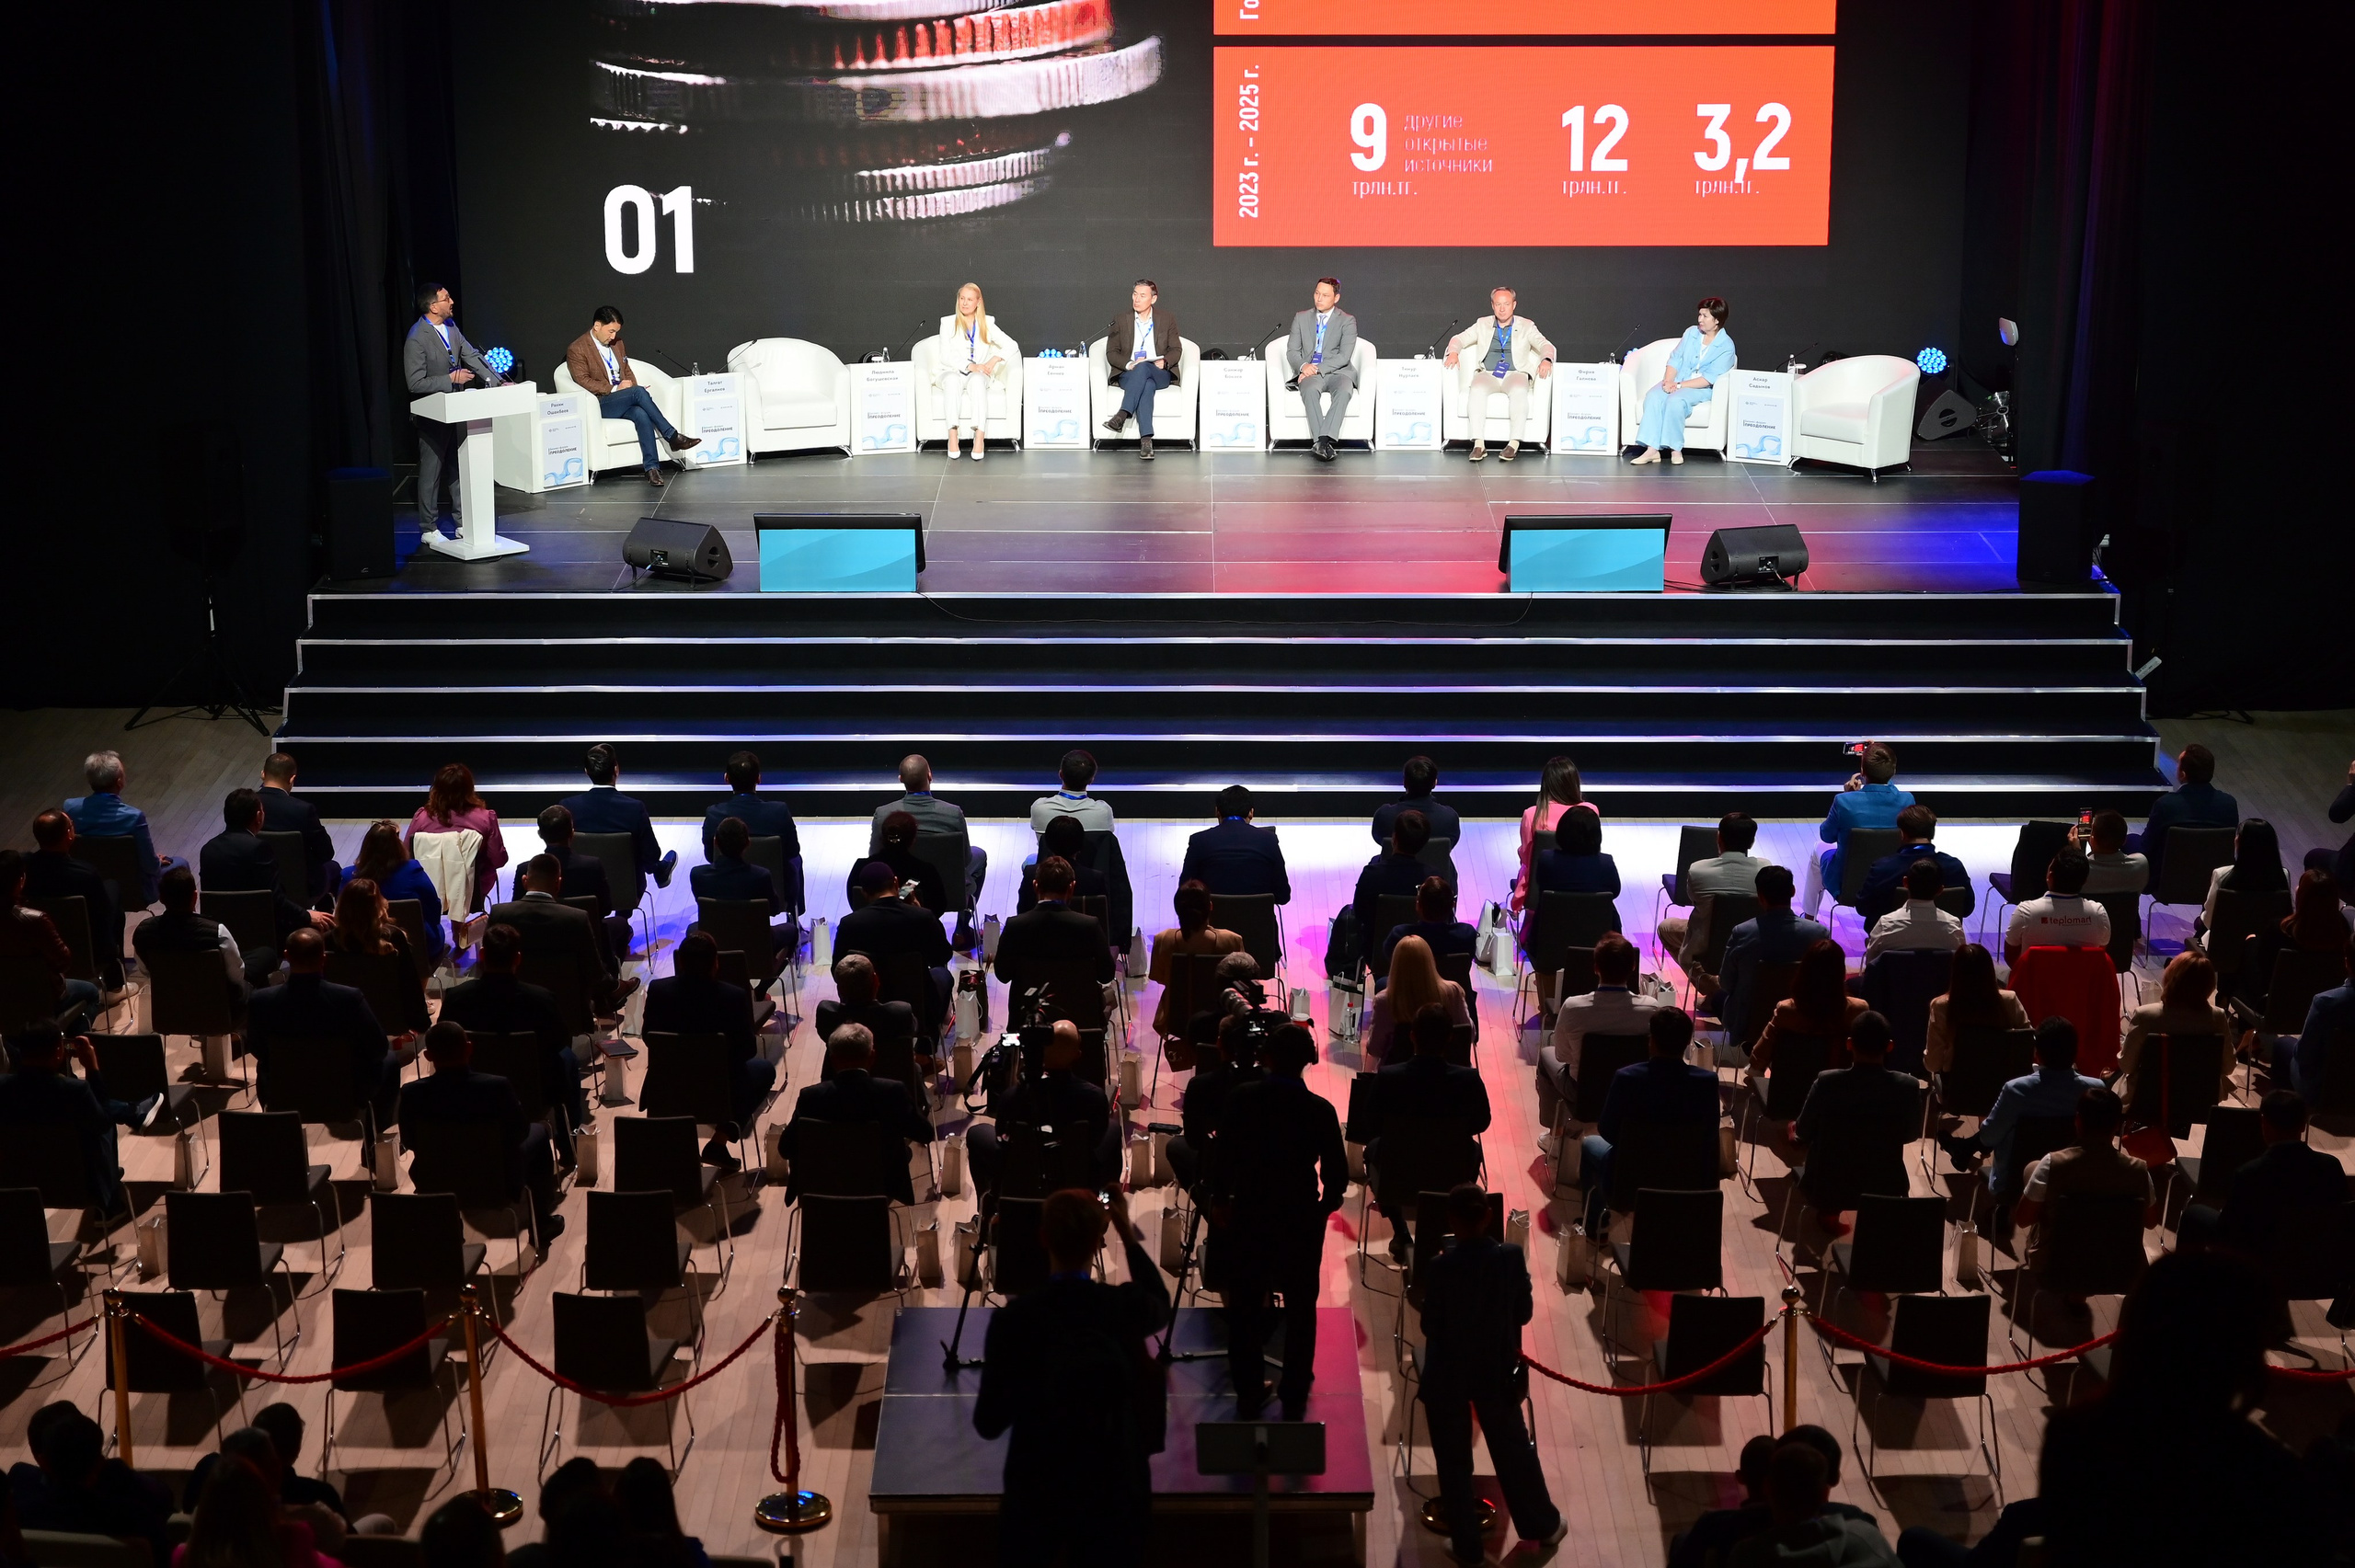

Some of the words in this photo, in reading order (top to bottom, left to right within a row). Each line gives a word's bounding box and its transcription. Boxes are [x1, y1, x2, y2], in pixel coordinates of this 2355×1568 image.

[1244, 64, 1260, 78] г.
[1238, 84, 1259, 132] 2025
[1404, 114, 1463, 132] другие
[1244, 153, 1259, 166] г.
[1350, 102, 1387, 172] 9
[1405, 137, 1488, 155] открытые
[1561, 104, 1629, 172] 12
[1694, 102, 1792, 184] 3,2
[1405, 158, 1492, 173] источники
[1238, 172, 1259, 218] 2023
[603, 184, 695, 275] 01
